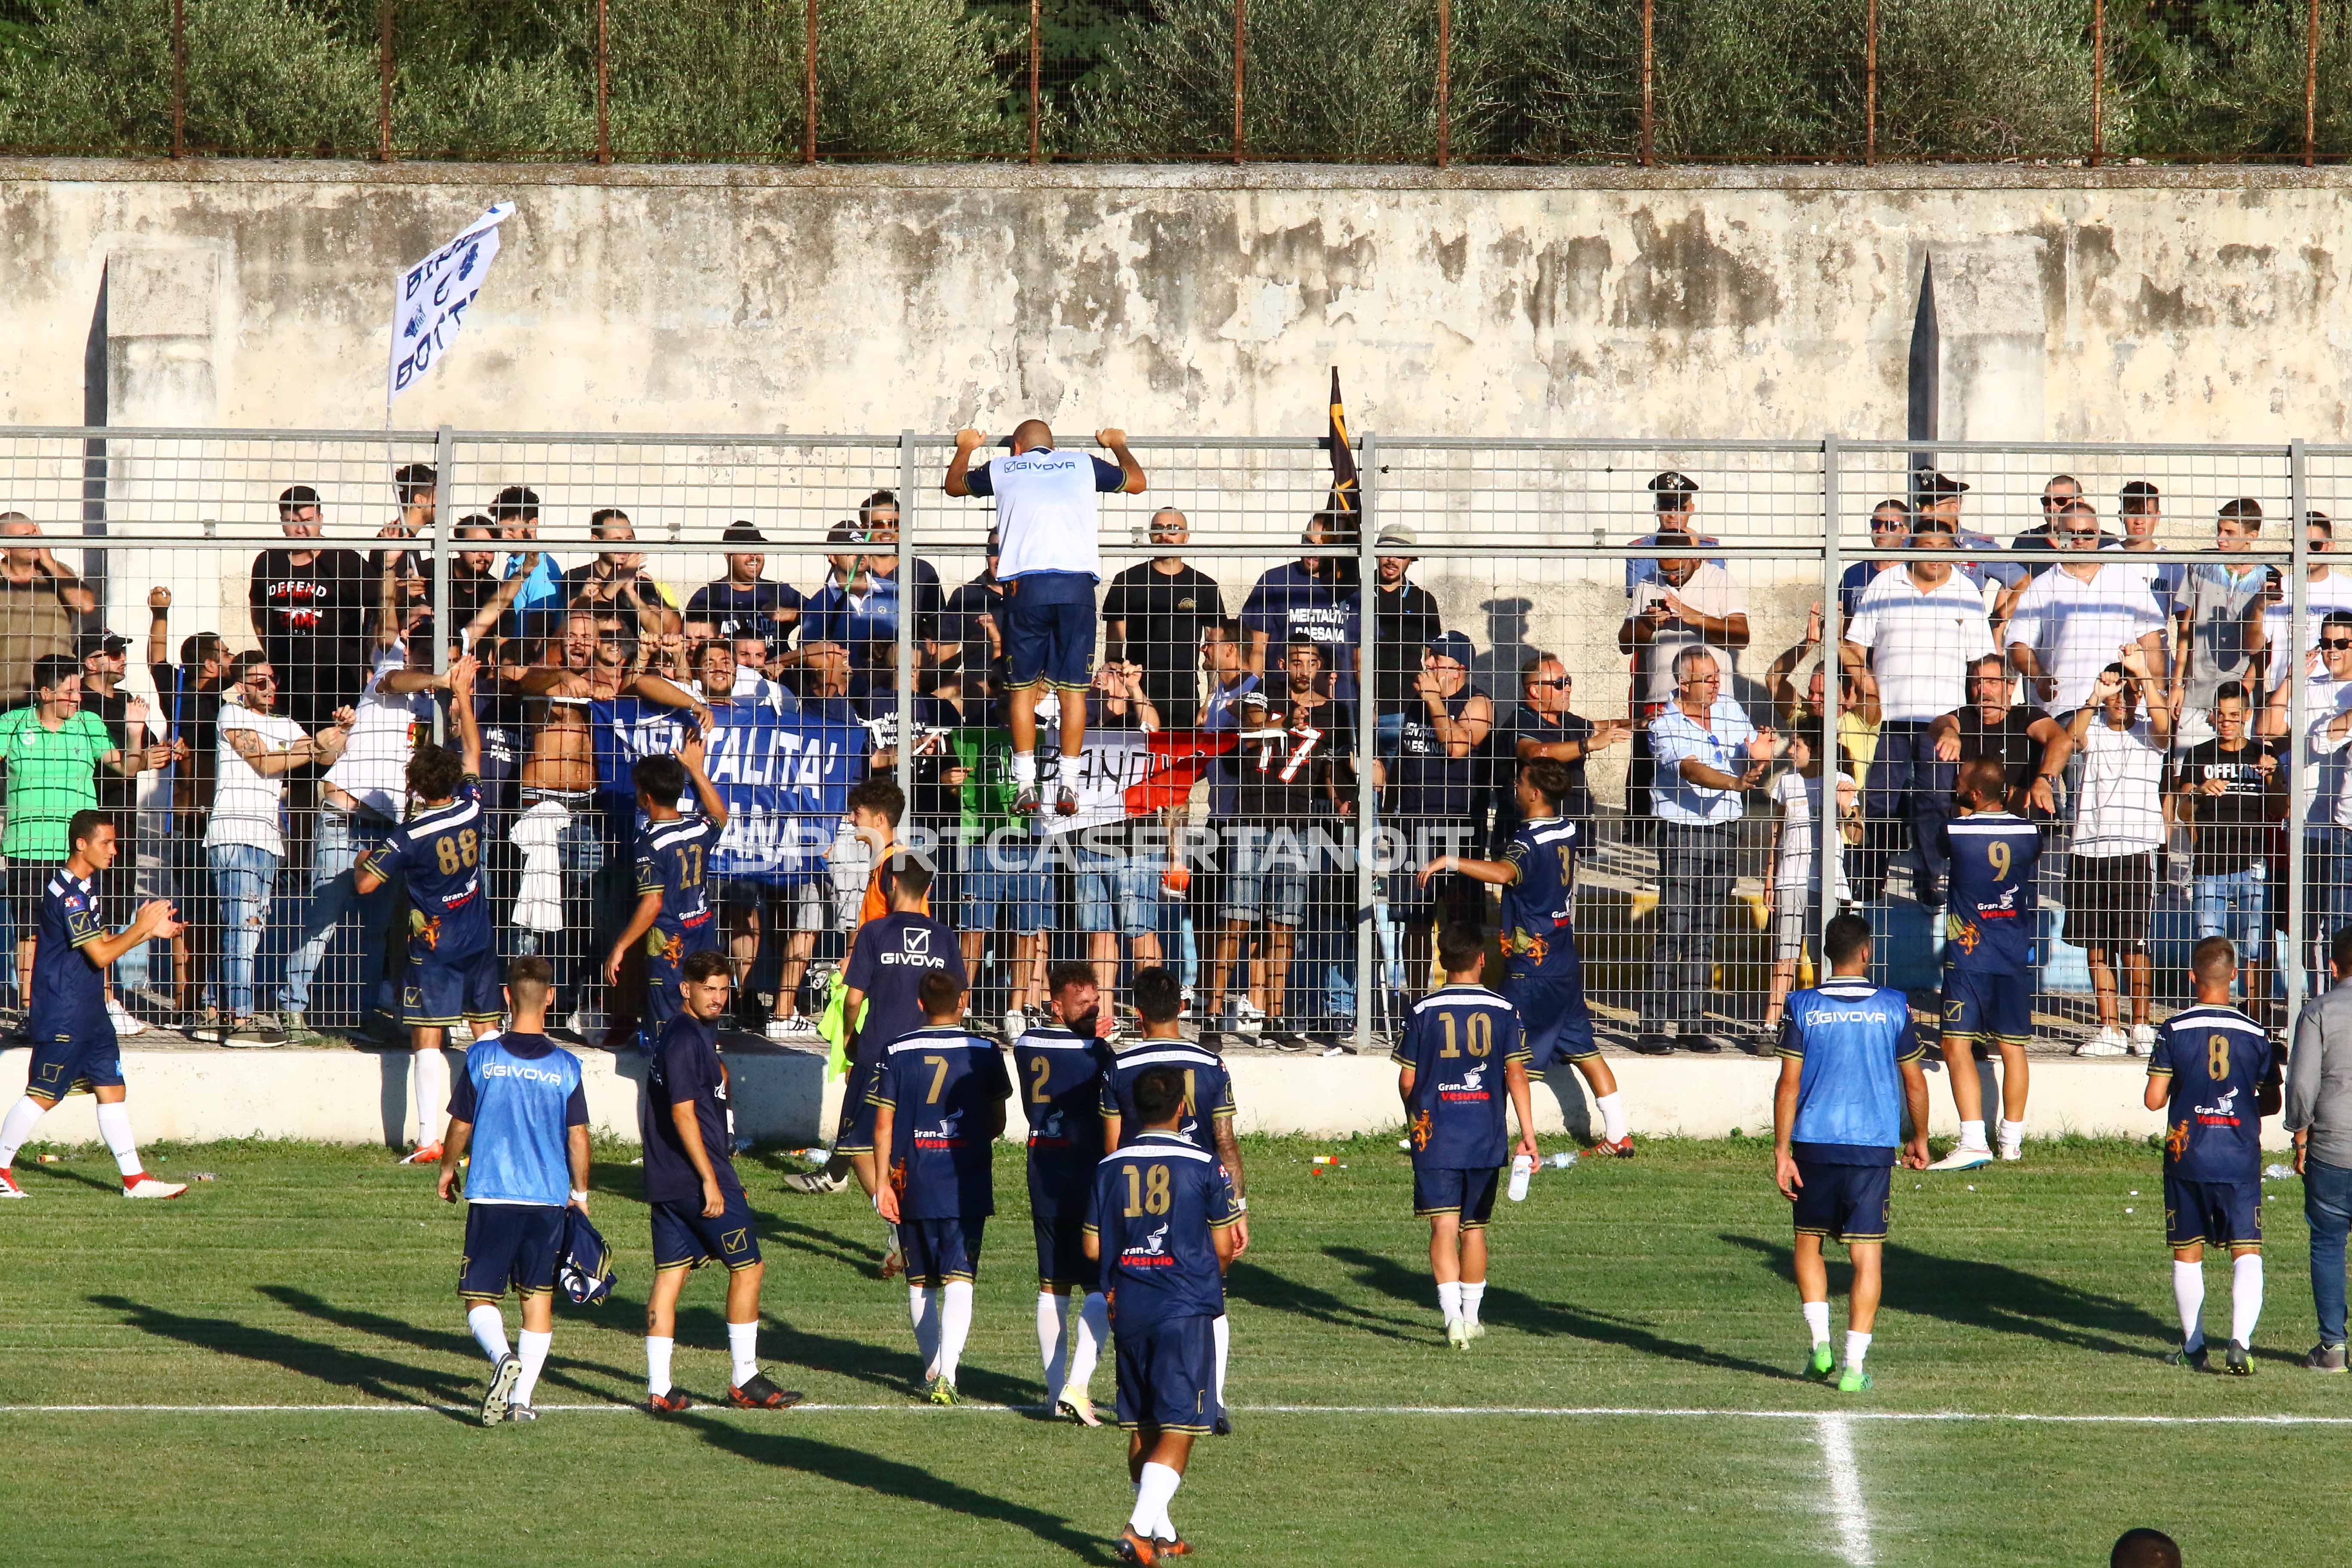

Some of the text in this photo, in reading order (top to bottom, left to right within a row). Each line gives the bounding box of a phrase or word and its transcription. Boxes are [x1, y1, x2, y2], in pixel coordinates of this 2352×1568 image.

[1016, 461, 1075, 470] GIVOVA
[269, 581, 327, 597] DEFEND
[435, 828, 478, 876] 88
[1988, 841, 2011, 881] 9
[676, 844, 702, 890] 17
[442, 892, 464, 902] Gran
[679, 910, 697, 920] Gran
[881, 952, 945, 969] GIVOVA
[1819, 1011, 1886, 1024] GIVOVA
[1439, 1011, 1492, 1058] 10
[2208, 1034, 2230, 1081] 8
[493, 1065, 561, 1087] GIVOVA
[924, 1056, 949, 1104] 7
[1031, 1056, 1051, 1103] 2
[1438, 1083, 1461, 1091] Gran
[1441, 1091, 1490, 1101] Vesuvio
[2194, 1105, 2214, 1115] Gran
[1122, 1164, 1170, 1218] 18
